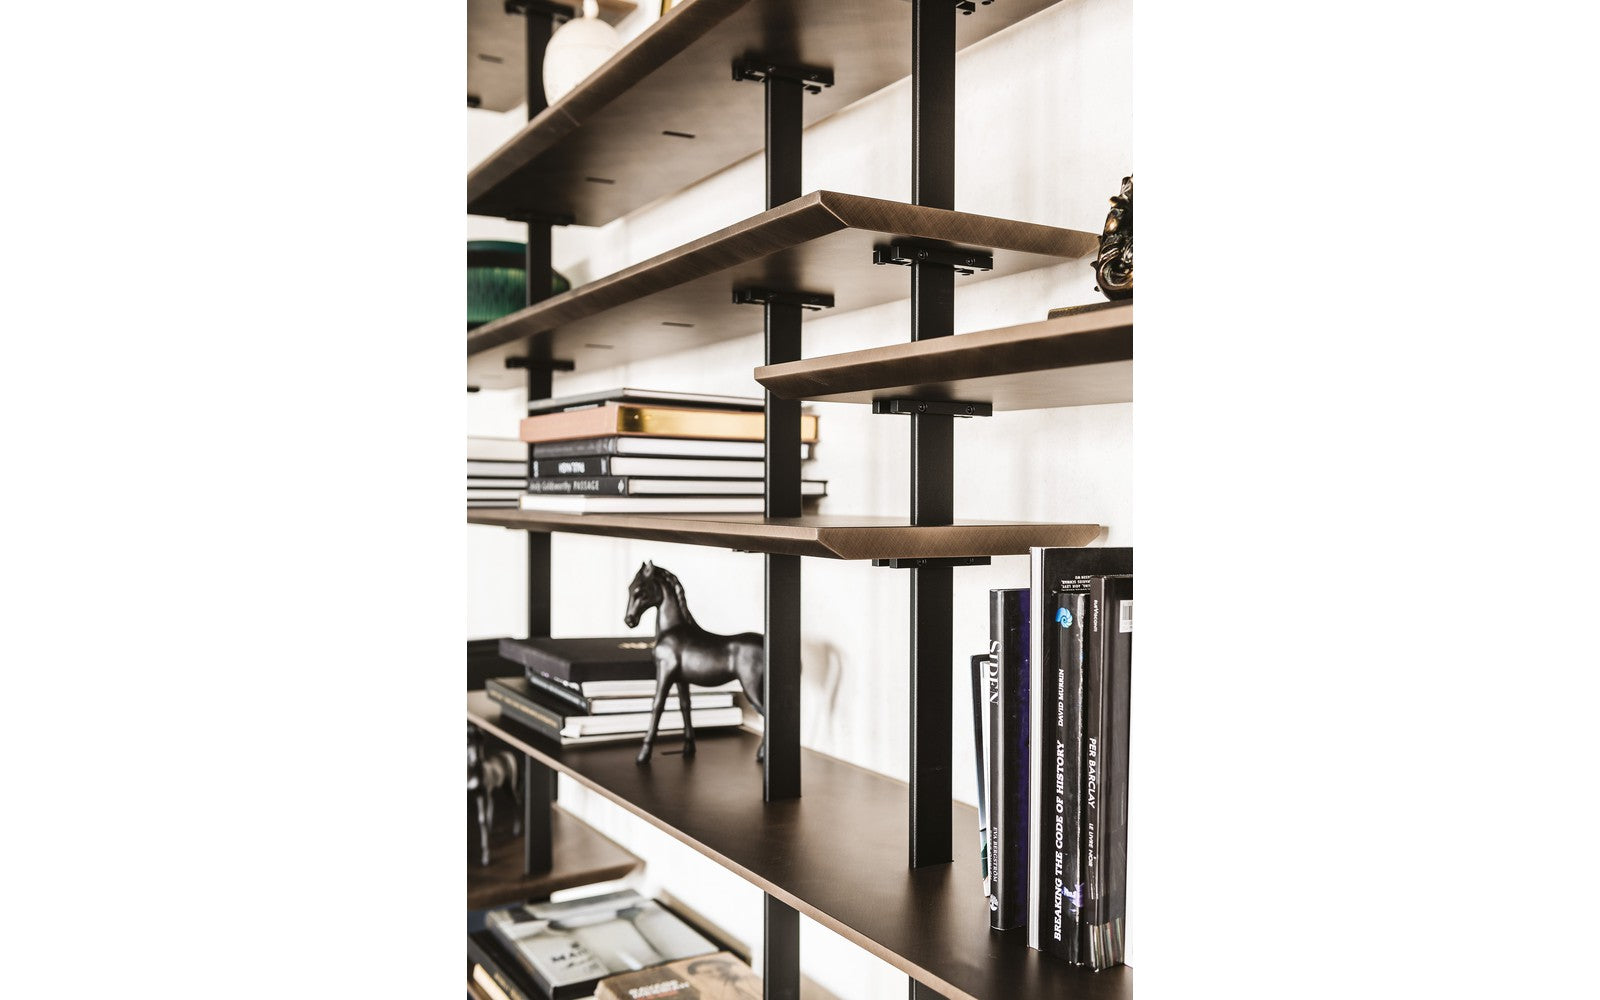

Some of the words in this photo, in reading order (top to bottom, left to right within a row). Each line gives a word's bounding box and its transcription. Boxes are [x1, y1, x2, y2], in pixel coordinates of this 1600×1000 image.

[573, 480, 600, 491] PASSAGE
[989, 640, 1003, 706] SIDEN
[1056, 740, 1065, 795] HISTORY
[1089, 738, 1097, 756] PER
[1057, 796, 1064, 813] OF
[1088, 760, 1096, 808] BARCLAY
[1056, 815, 1064, 849] CODE
[1053, 878, 1063, 941] BREAKING
